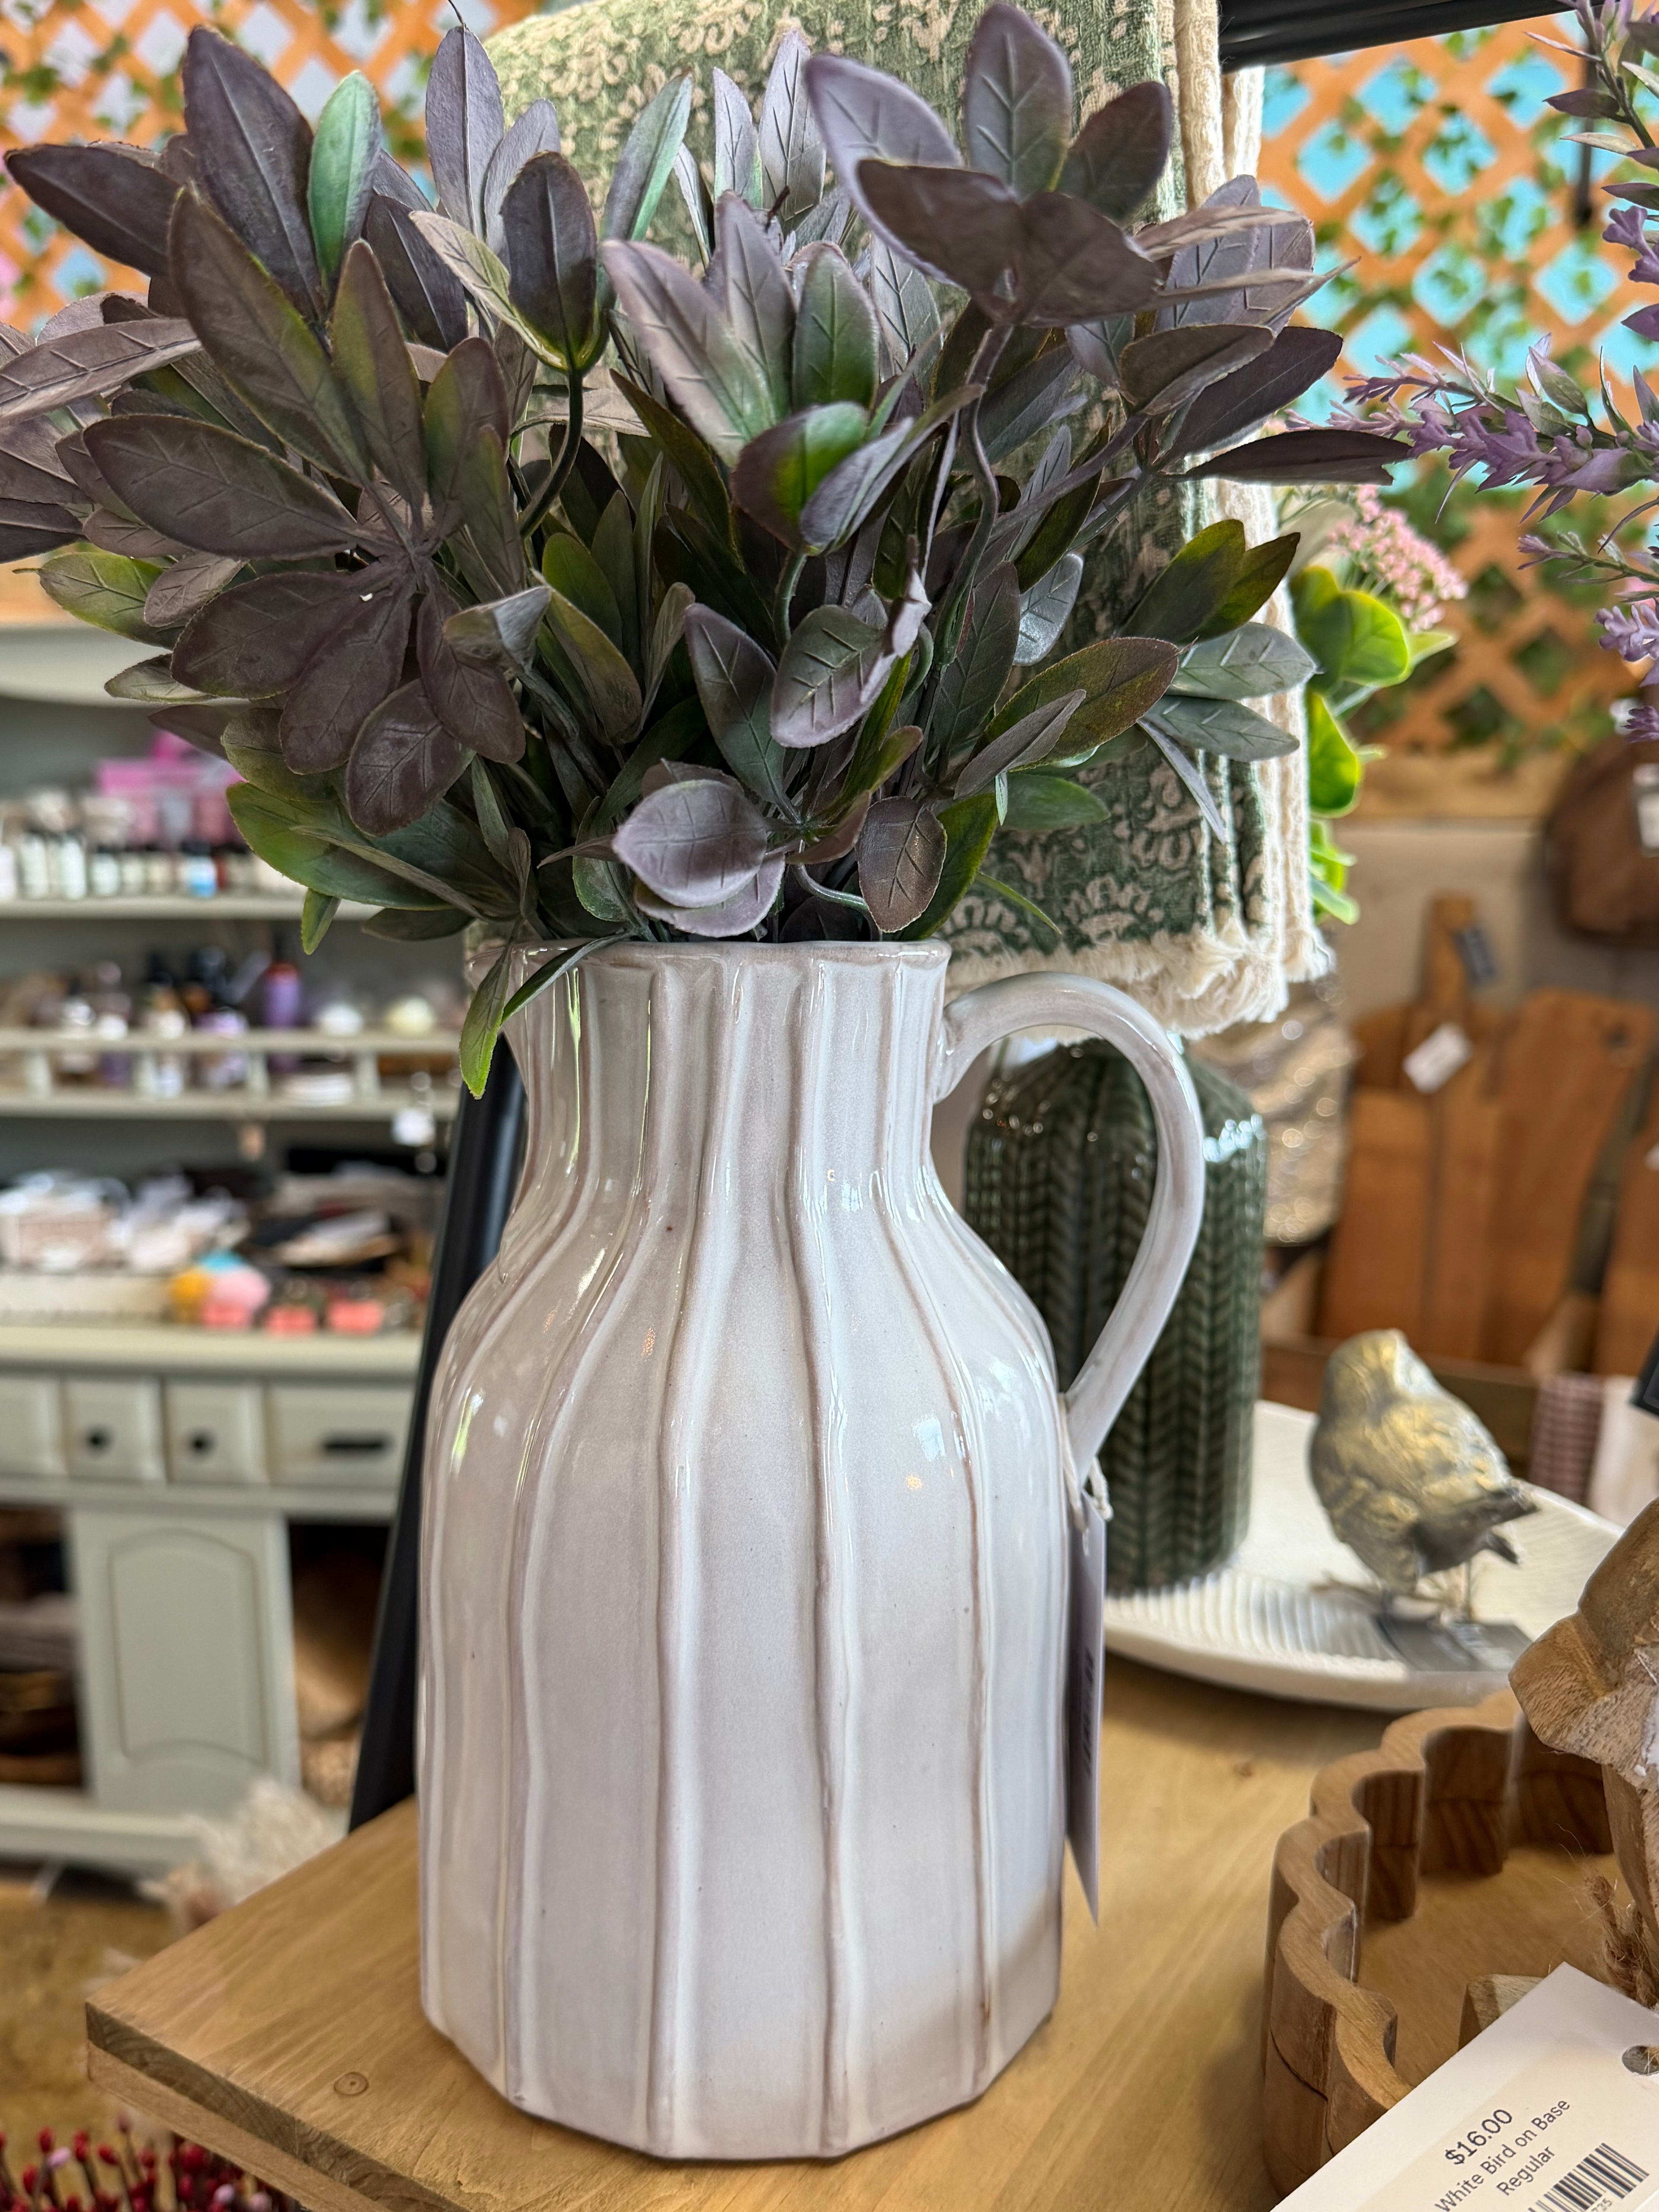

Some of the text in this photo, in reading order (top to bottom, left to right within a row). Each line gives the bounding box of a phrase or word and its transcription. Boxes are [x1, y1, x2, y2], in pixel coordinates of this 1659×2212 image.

[1434, 2101, 1570, 2212] White Bird on Base
[1445, 2109, 1512, 2164] $16.00
[1496, 2146, 1555, 2196] Regular
